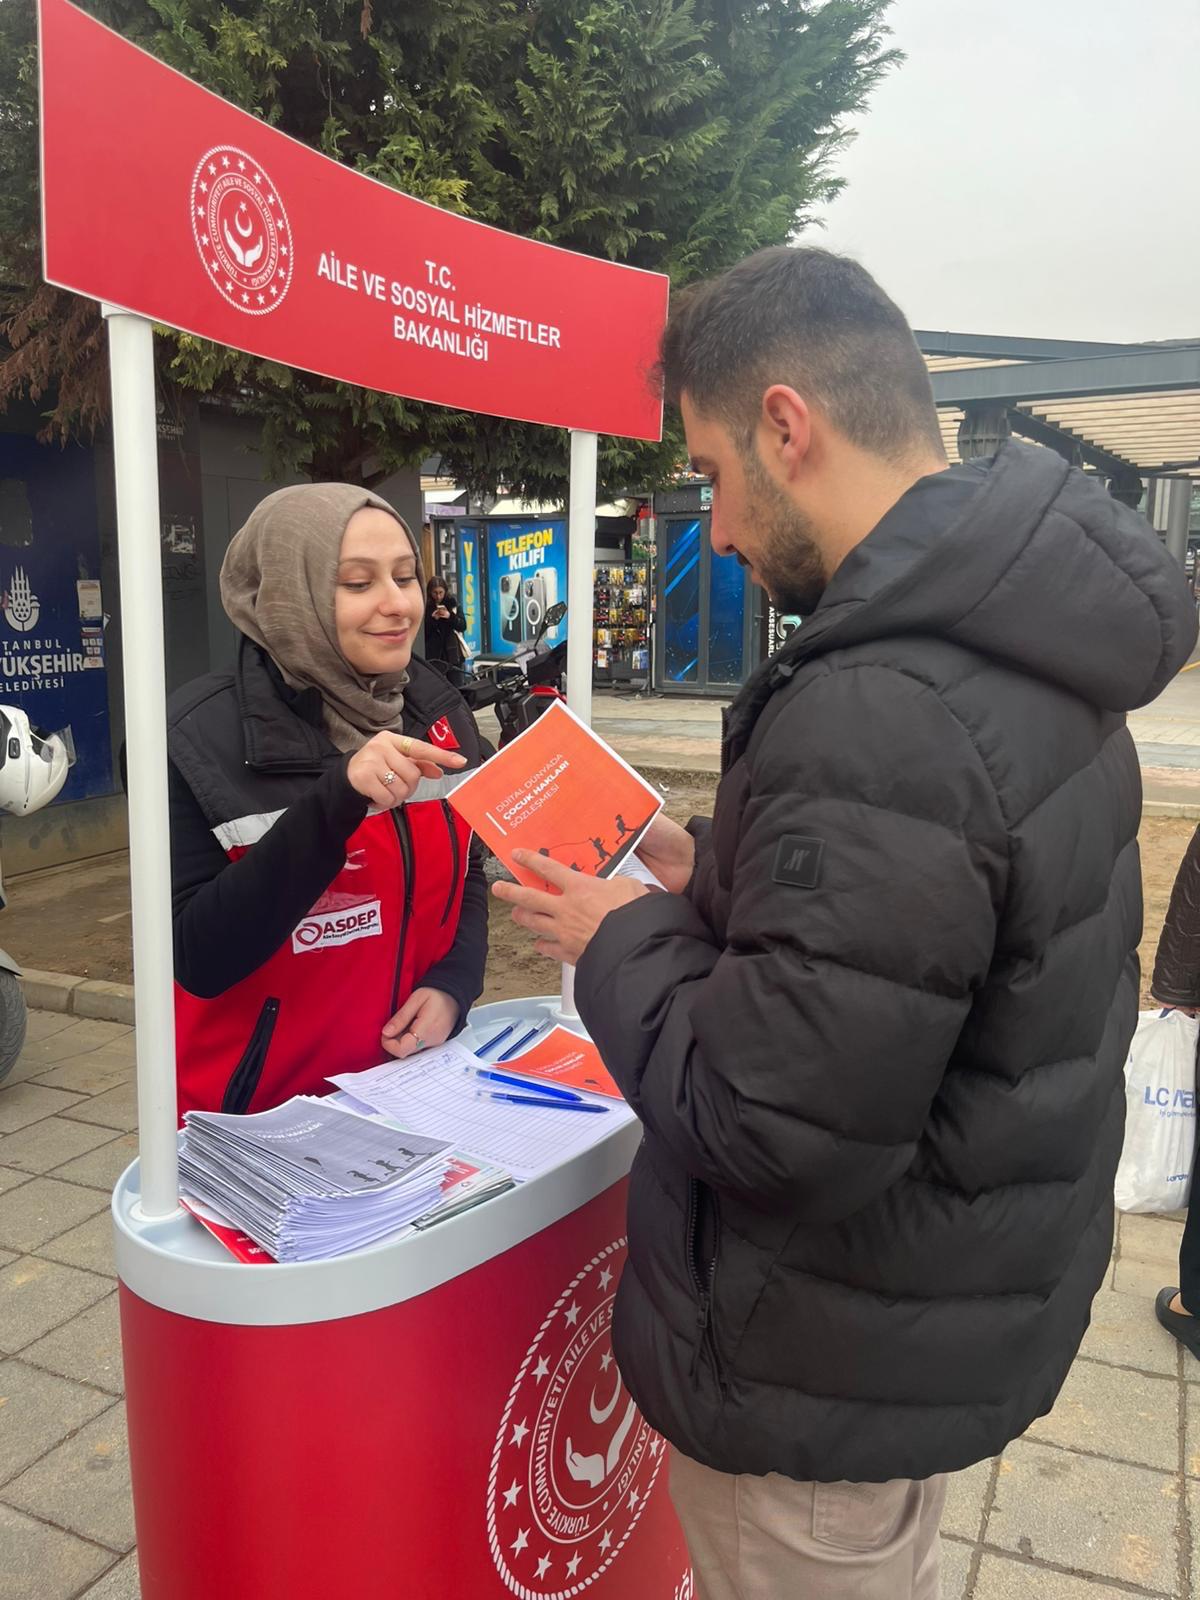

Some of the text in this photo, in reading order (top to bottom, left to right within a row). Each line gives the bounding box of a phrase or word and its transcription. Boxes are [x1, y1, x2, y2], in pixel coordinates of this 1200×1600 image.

[425, 260, 456, 291] T.C.
[317, 250, 561, 349] AİLE VE SOSYAL HİZMETLER
[393, 314, 489, 362] BAKANLIĞI
[496, 528, 553, 558] TELEFON
[509, 546, 545, 571] KILIFI
[2, 639, 62, 650] TANBUL
[0, 648, 84, 680] ÜKŞEHİR
[0, 676, 64, 692] ELEDİYESİ
[503, 760, 570, 821] ÇOCUK HAKLARI
[323, 909, 377, 934] ASDEP
[1144, 1086, 1169, 1106] LC
[534, 1311, 607, 1537] TÜRKİYE CUMHURİYETİ AİLE VE
